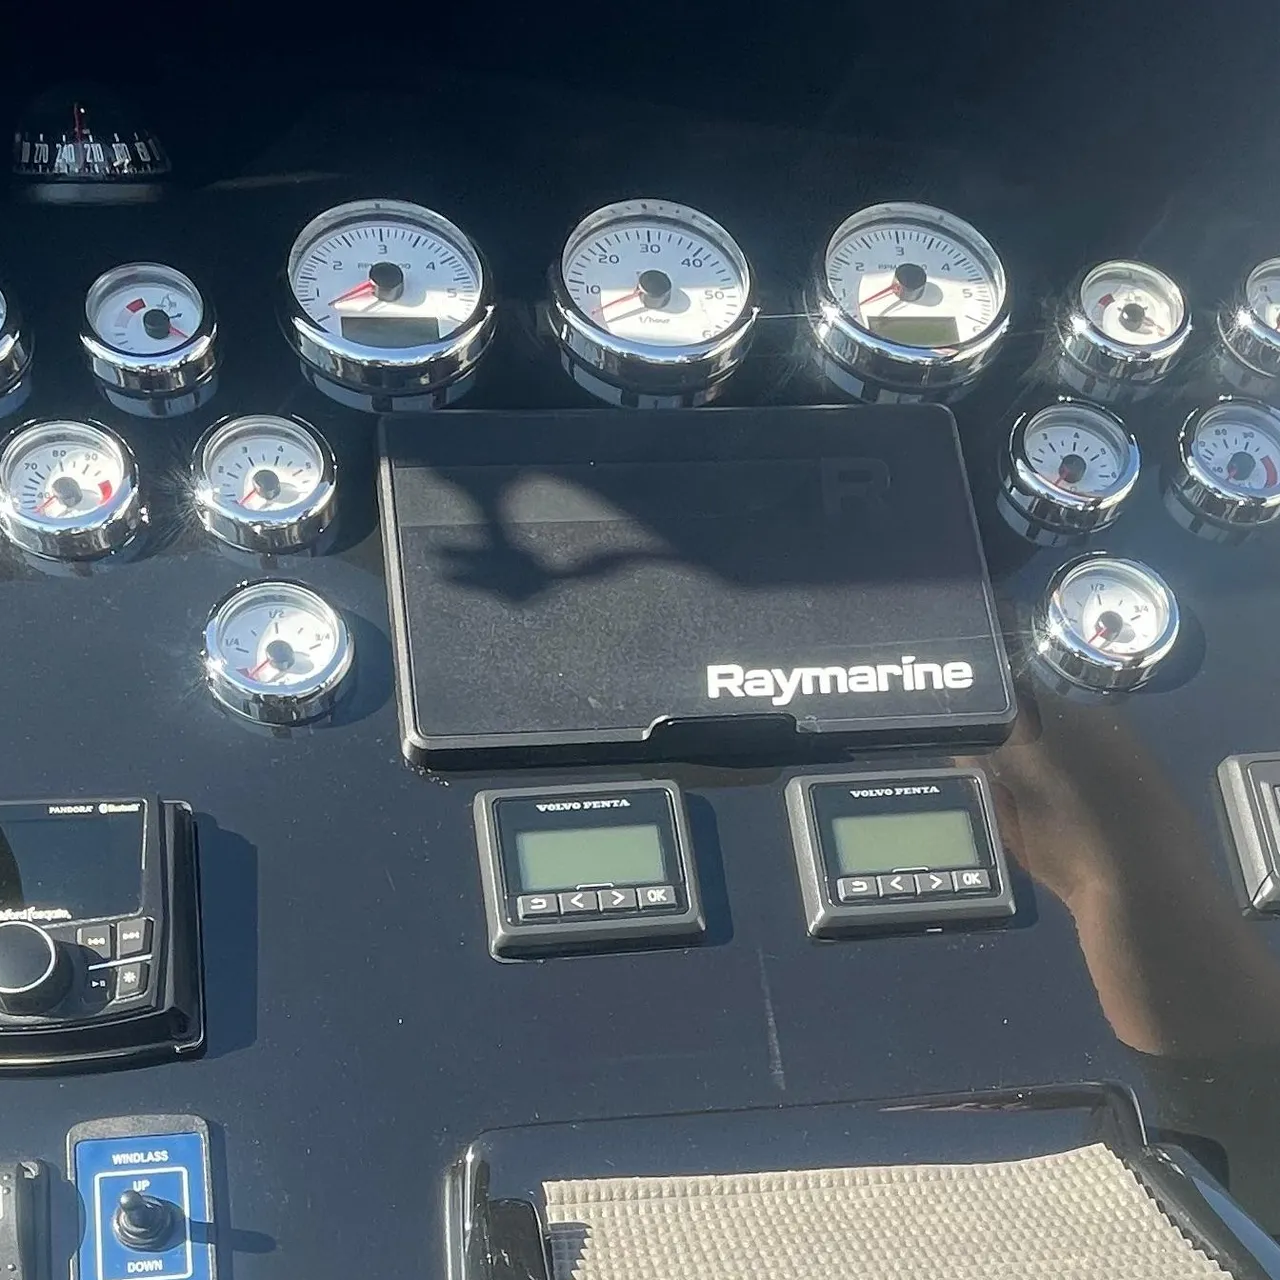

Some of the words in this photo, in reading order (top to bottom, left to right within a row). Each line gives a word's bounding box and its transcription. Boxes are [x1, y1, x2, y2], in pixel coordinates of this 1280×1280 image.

[377, 244, 388, 255] 3
[639, 243, 661, 254] 30
[895, 246, 905, 256] 3
[598, 254, 620, 265] 20
[681, 258, 703, 268] 40
[333, 261, 343, 271] 2
[425, 261, 436, 271] 4
[855, 262, 865, 272] 2
[941, 262, 951, 272] 4
[447, 288, 458, 298] 5
[585, 285, 601, 294] 10
[962, 289, 973, 299] 5
[704, 290, 725, 300] 50
[52, 450, 67, 458] 80
[84, 453, 99, 462] 90
[23, 462, 38, 471] 70
[268, 610, 284, 619] 1/2
[225, 638, 240, 647] 1/4
[706, 655, 974, 706] Raymarine
[849, 788, 894, 798] VOLVO
[894, 786, 940, 796] PENTA
[536, 802, 581, 813] VOLVO
[583, 799, 630, 809] PENTA
[962, 872, 982, 886] OK
[646, 889, 667, 902] OK
[112, 1150, 169, 1165] WINDLASS
[132, 1180, 150, 1192] UP
[127, 1260, 163, 1273] DOWN
